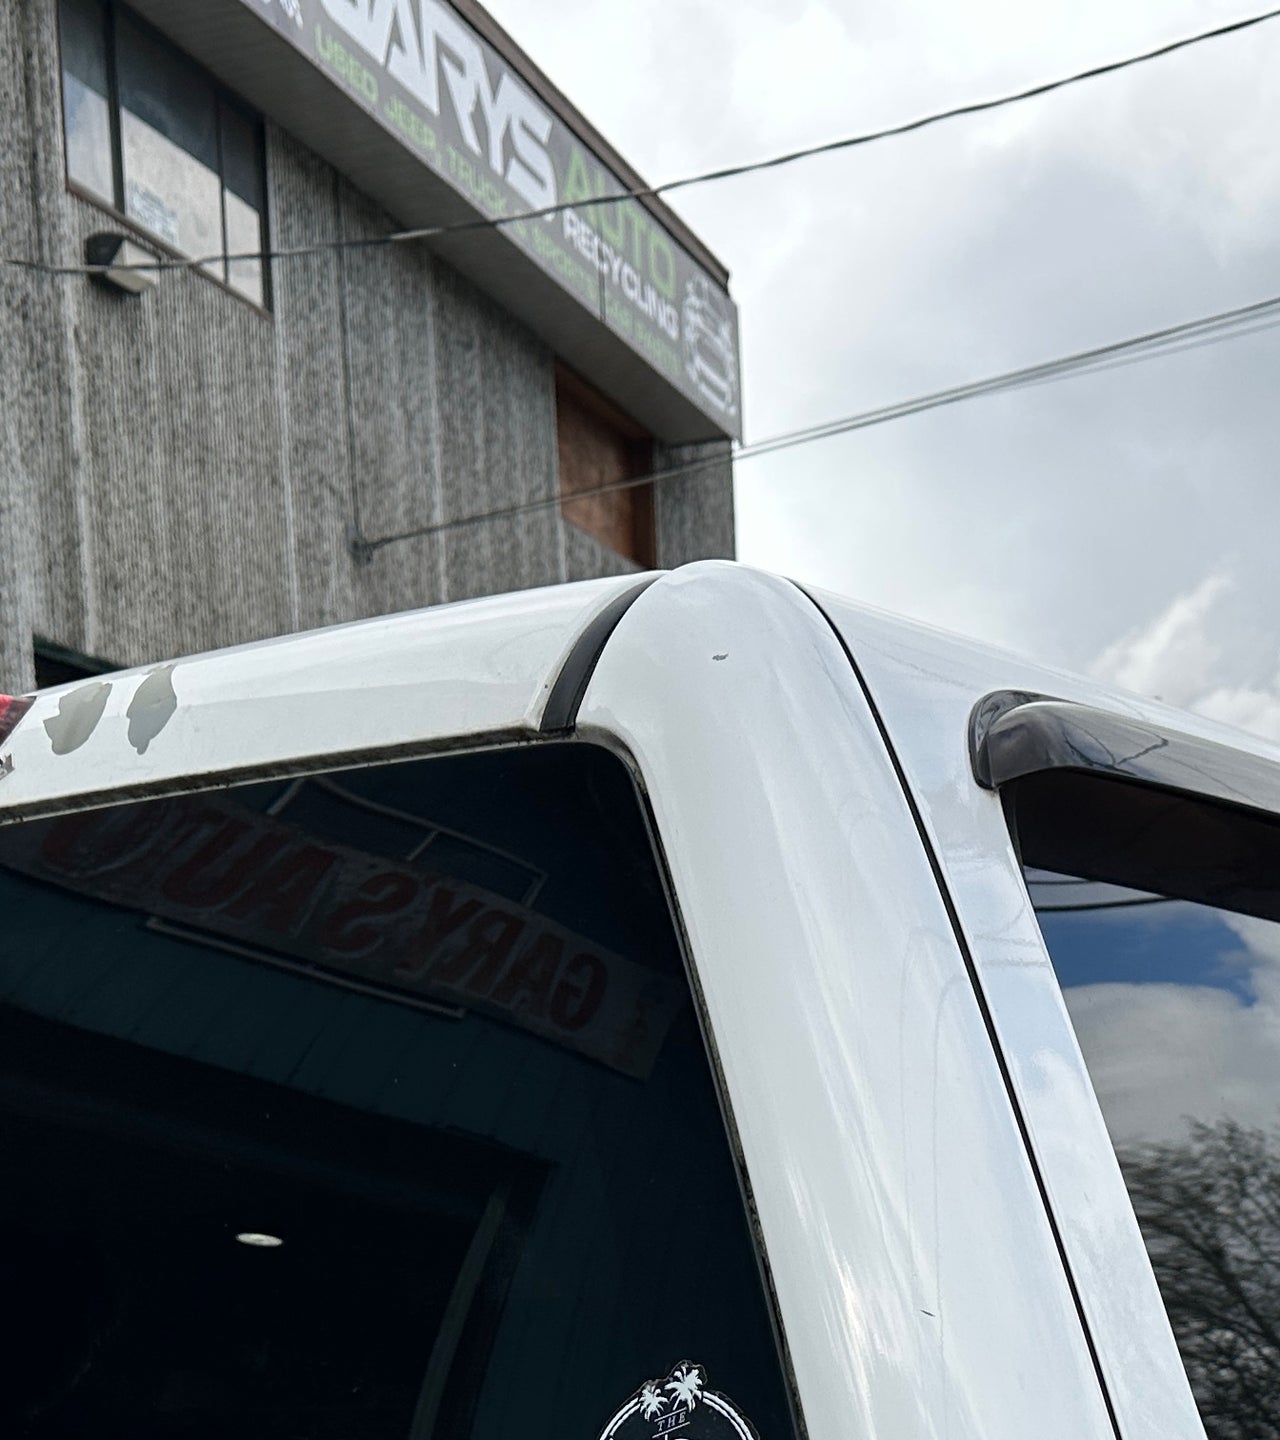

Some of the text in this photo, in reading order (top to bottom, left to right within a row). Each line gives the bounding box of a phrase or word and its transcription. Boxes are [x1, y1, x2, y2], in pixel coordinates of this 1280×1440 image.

[314, 23, 380, 104] USED
[562, 207, 680, 341] RECYCLING
[563, 145, 677, 299] AUTO
[657, 1410, 687, 1432] THE
